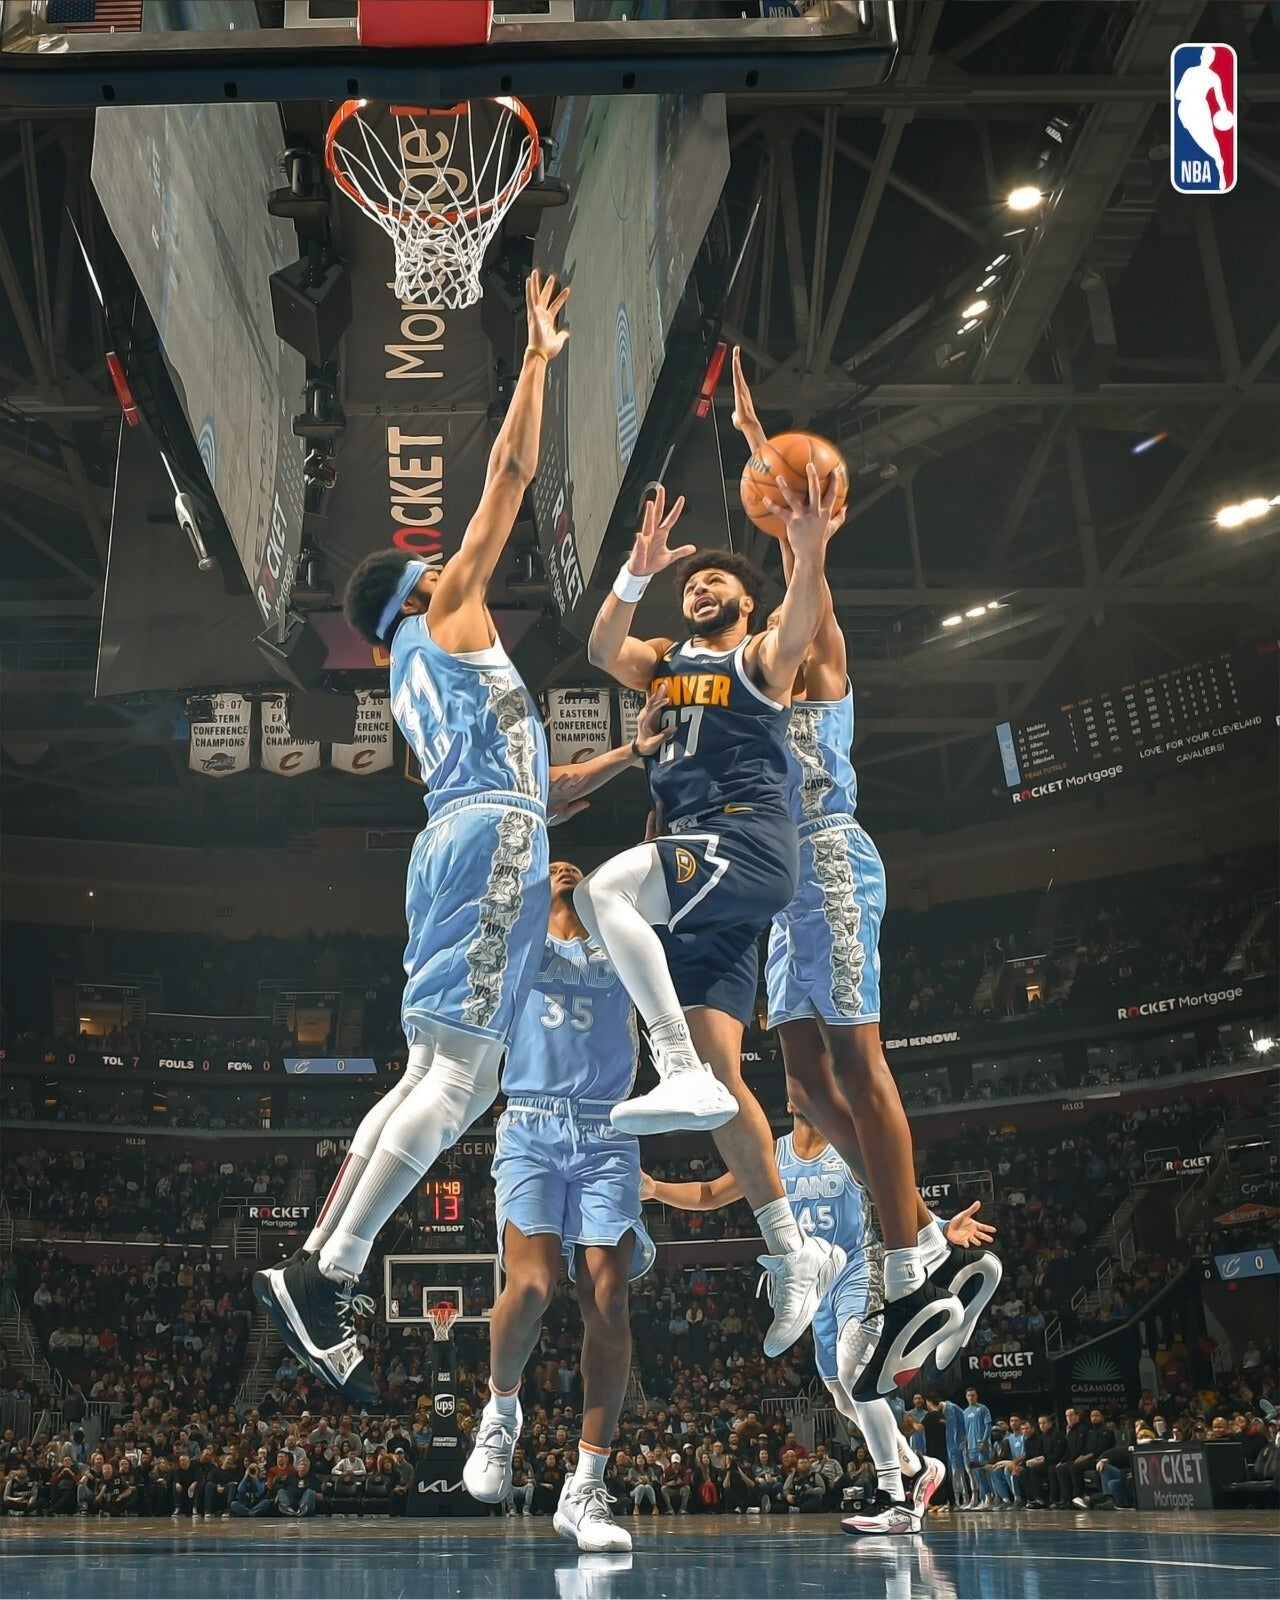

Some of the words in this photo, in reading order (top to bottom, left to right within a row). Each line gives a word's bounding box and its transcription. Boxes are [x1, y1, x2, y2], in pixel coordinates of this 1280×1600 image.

[768, 6, 793, 17] NBA
[257, 491, 287, 620] ROCKET
[551, 487, 583, 612] ROCKET
[652, 674, 731, 707] NVER
[213, 699, 242, 710] 06-07
[558, 695, 600, 705] 2017-18
[213, 714, 241, 723] STERN
[355, 711, 382, 719] STERN
[560, 709, 599, 718] EASTERN
[193, 726, 248, 735] CONFERENCE
[553, 720, 608, 730] CONFERENCE
[353, 734, 388, 744] MPIONS
[555, 732, 606, 742] CHAMPIONS
[659, 706, 705, 765] 27
[1166, 739, 1184, 753] FOR
[1185, 732, 1210, 746] YOUR
[1211, 716, 1262, 738] CLEVELAND
[195, 738, 245, 747] CHAMPIONS
[266, 737, 315, 746] CHAMPIONS
[1176, 743, 1226, 763] CAVALIERS!
[1012, 779, 1064, 804] ROCKET
[1066, 764, 1123, 788] Mortgage
[1117, 998, 1176, 1020] ROCKET
[1179, 987, 1243, 1009] Mortgage
[540, 993, 594, 1031] 35
[909, 1031, 961, 1047] KNOW.
[68, 1053, 76, 1064] 0
[102, 1056, 124, 1066] TOL
[132, 1056, 140, 1067] 7
[741, 1052, 762, 1061] TOL
[769, 1050, 777, 1061] 7
[159, 1059, 194, 1070] FOULS
[202, 1060, 210, 1071] 0
[227, 1062, 252, 1071] FG%
[263, 1060, 271, 1071] 0
[336, 1060, 345, 1071] 0
[1166, 1155, 1212, 1171] ROCKET
[426, 1181, 461, 1195] 11:48
[917, 1183, 951, 1198] KET
[249, 1206, 310, 1218] ROCKET
[435, 1195, 458, 1220] 13
[261, 1219, 298, 1228] Mortgage
[799, 1205, 835, 1232] 45
[1254, 1255, 1264, 1270] 0
[968, 1351, 1035, 1370] ROCKET
[983, 1369, 1023, 1380] Mortgage
[1071, 1383, 1126, 1393] CASAMIGOS
[436, 1401, 453, 1414] ups
[1137, 1452, 1203, 1486] ROCKET
[1153, 1490, 1195, 1511] Mortgage
